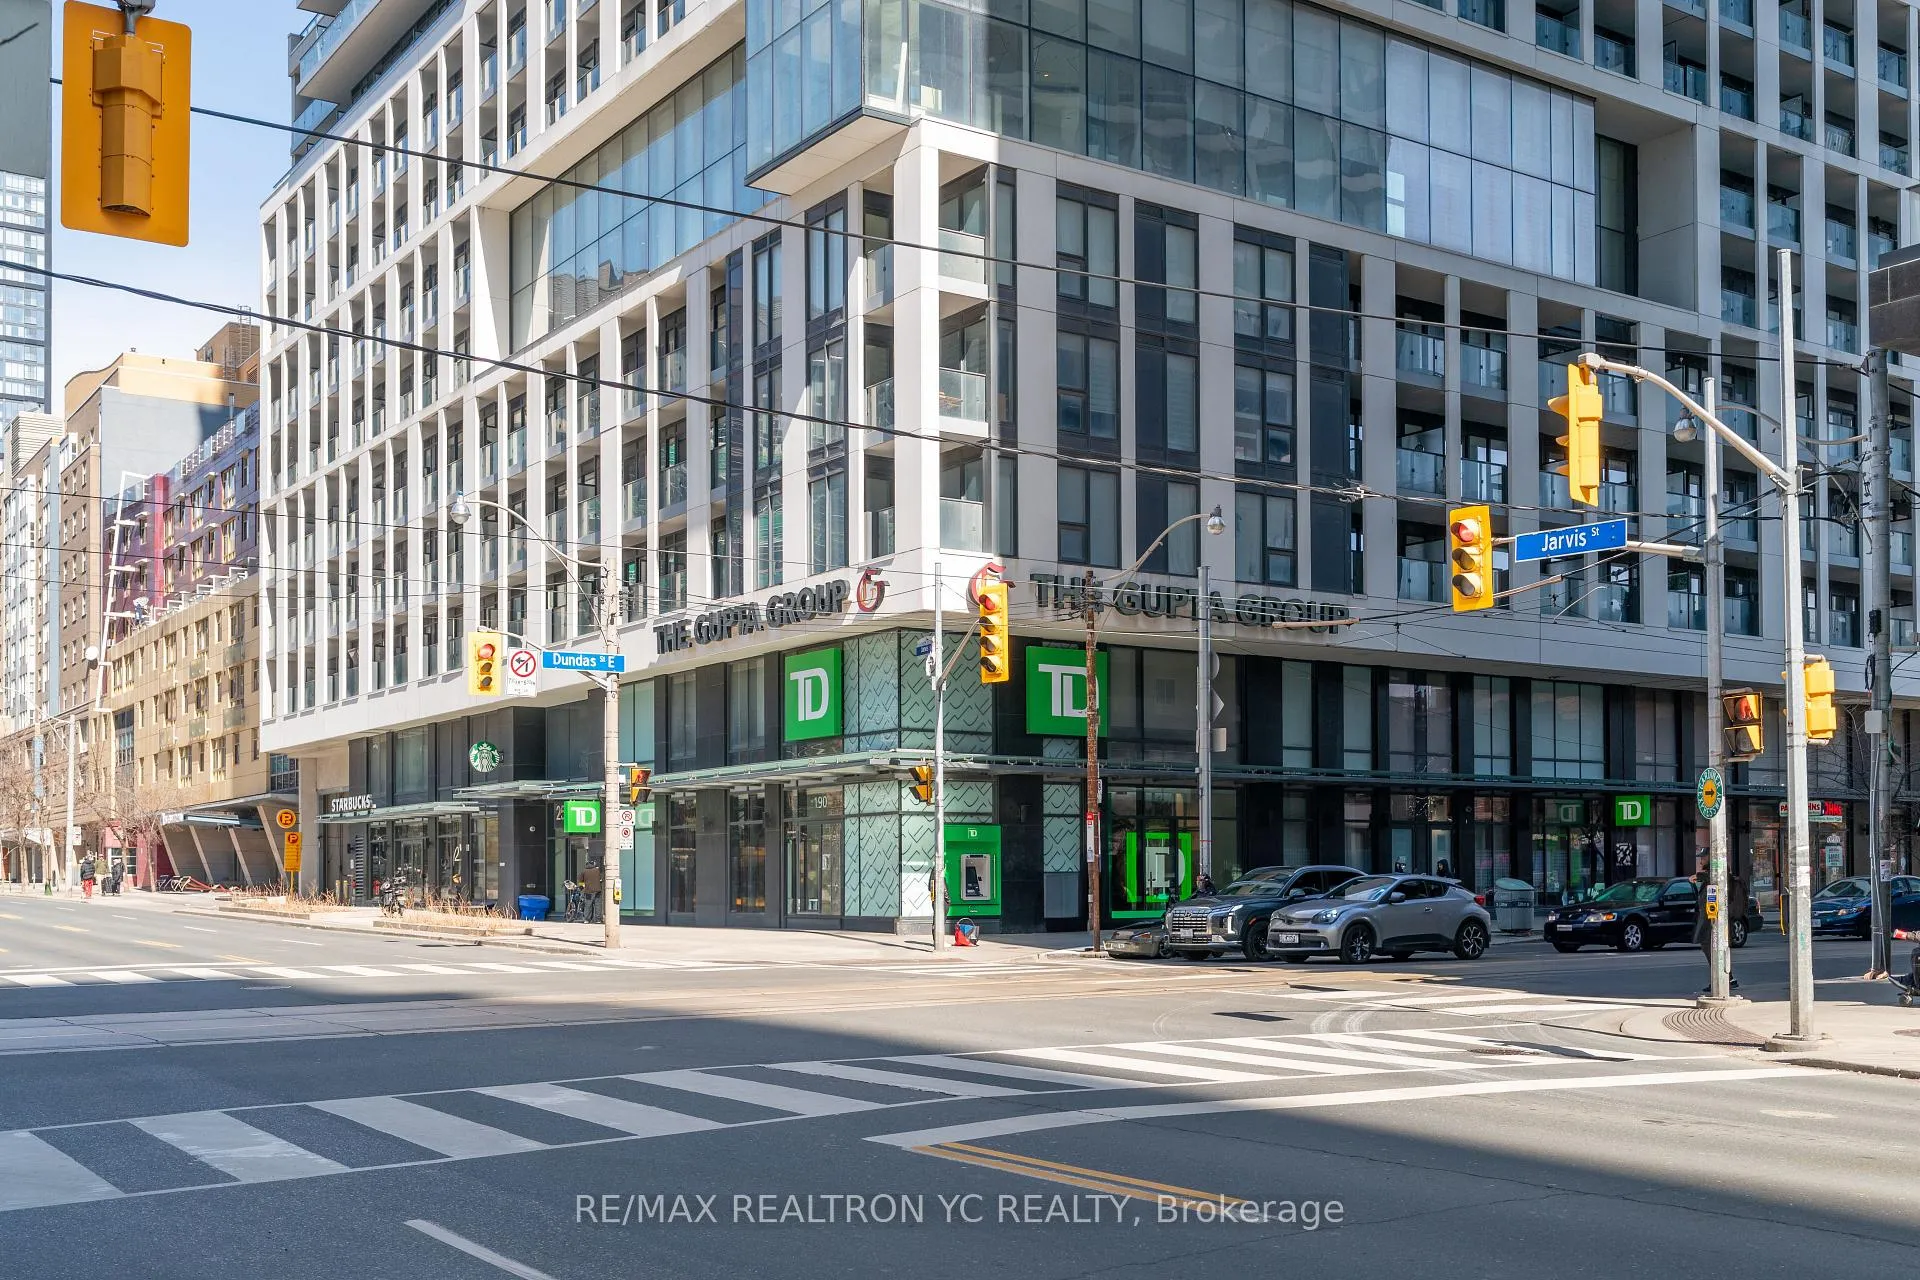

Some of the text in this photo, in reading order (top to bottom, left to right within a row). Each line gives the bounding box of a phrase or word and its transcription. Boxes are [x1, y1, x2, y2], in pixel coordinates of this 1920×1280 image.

[1541, 527, 1600, 552] Jarvis St
[1030, 573, 1350, 635] THE GUPTA GROUP
[653, 578, 851, 655] THE GUPTA GROUP
[552, 652, 597, 667] Dundas
[608, 656, 615, 668] E
[789, 667, 830, 722] TD
[1038, 663, 1099, 718] TD
[331, 793, 374, 813] STARBUCKS
[814, 795, 828, 809] 190
[1618, 800, 1642, 820] TD
[570, 806, 597, 827] TD
